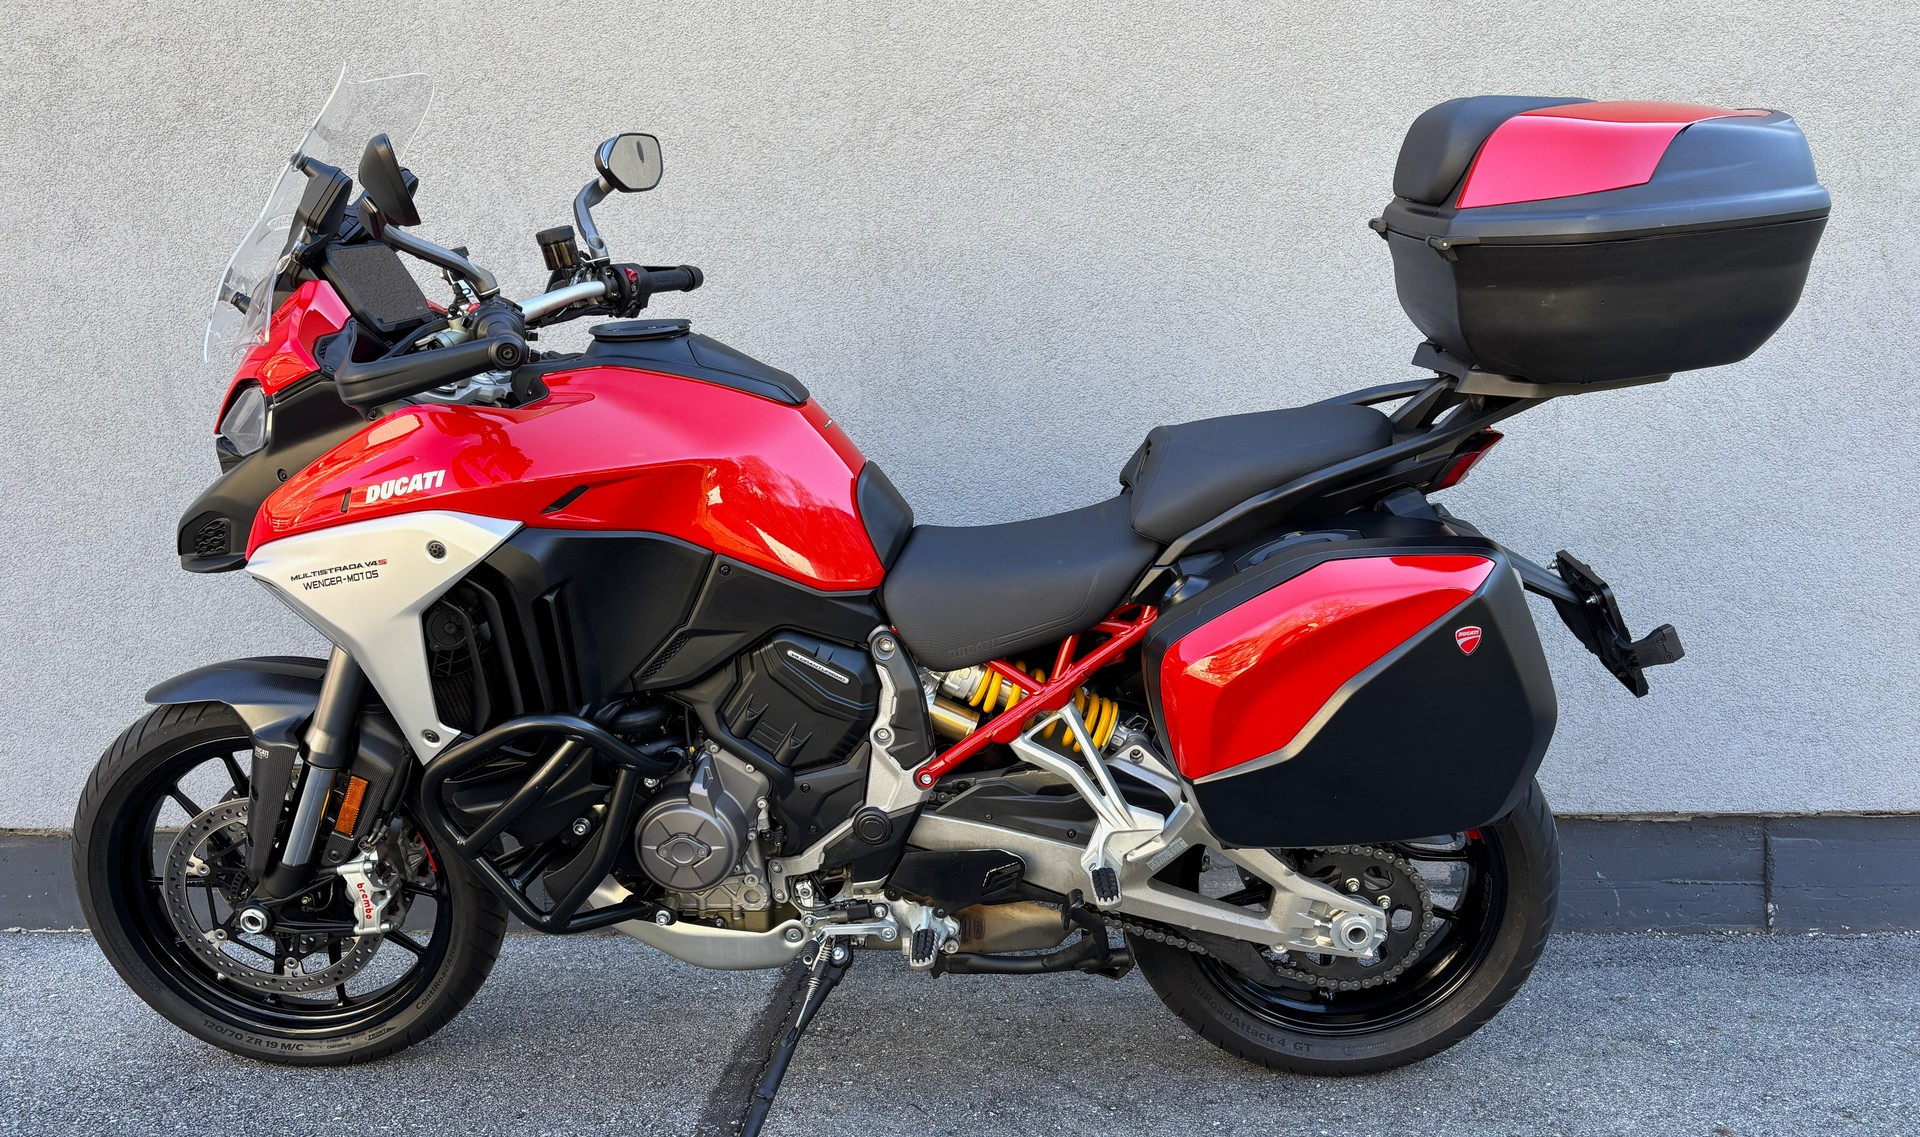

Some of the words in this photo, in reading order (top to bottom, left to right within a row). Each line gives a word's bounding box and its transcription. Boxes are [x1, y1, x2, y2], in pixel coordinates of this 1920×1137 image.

[365, 469, 446, 504] DUCATI
[290, 562, 364, 581] MULTISTRADA
[303, 569, 379, 590] WENGER-MOTOS
[356, 882, 374, 920] brembo
[1182, 963, 1274, 1044] ContiRoadAttack
[1277, 1038, 1287, 1047] 4
[1293, 1041, 1313, 1052] GT
[203, 1020, 244, 1041] 120/70
[246, 1035, 263, 1046] ZR
[265, 1040, 278, 1049] 19
[280, 1042, 304, 1051] M/C
